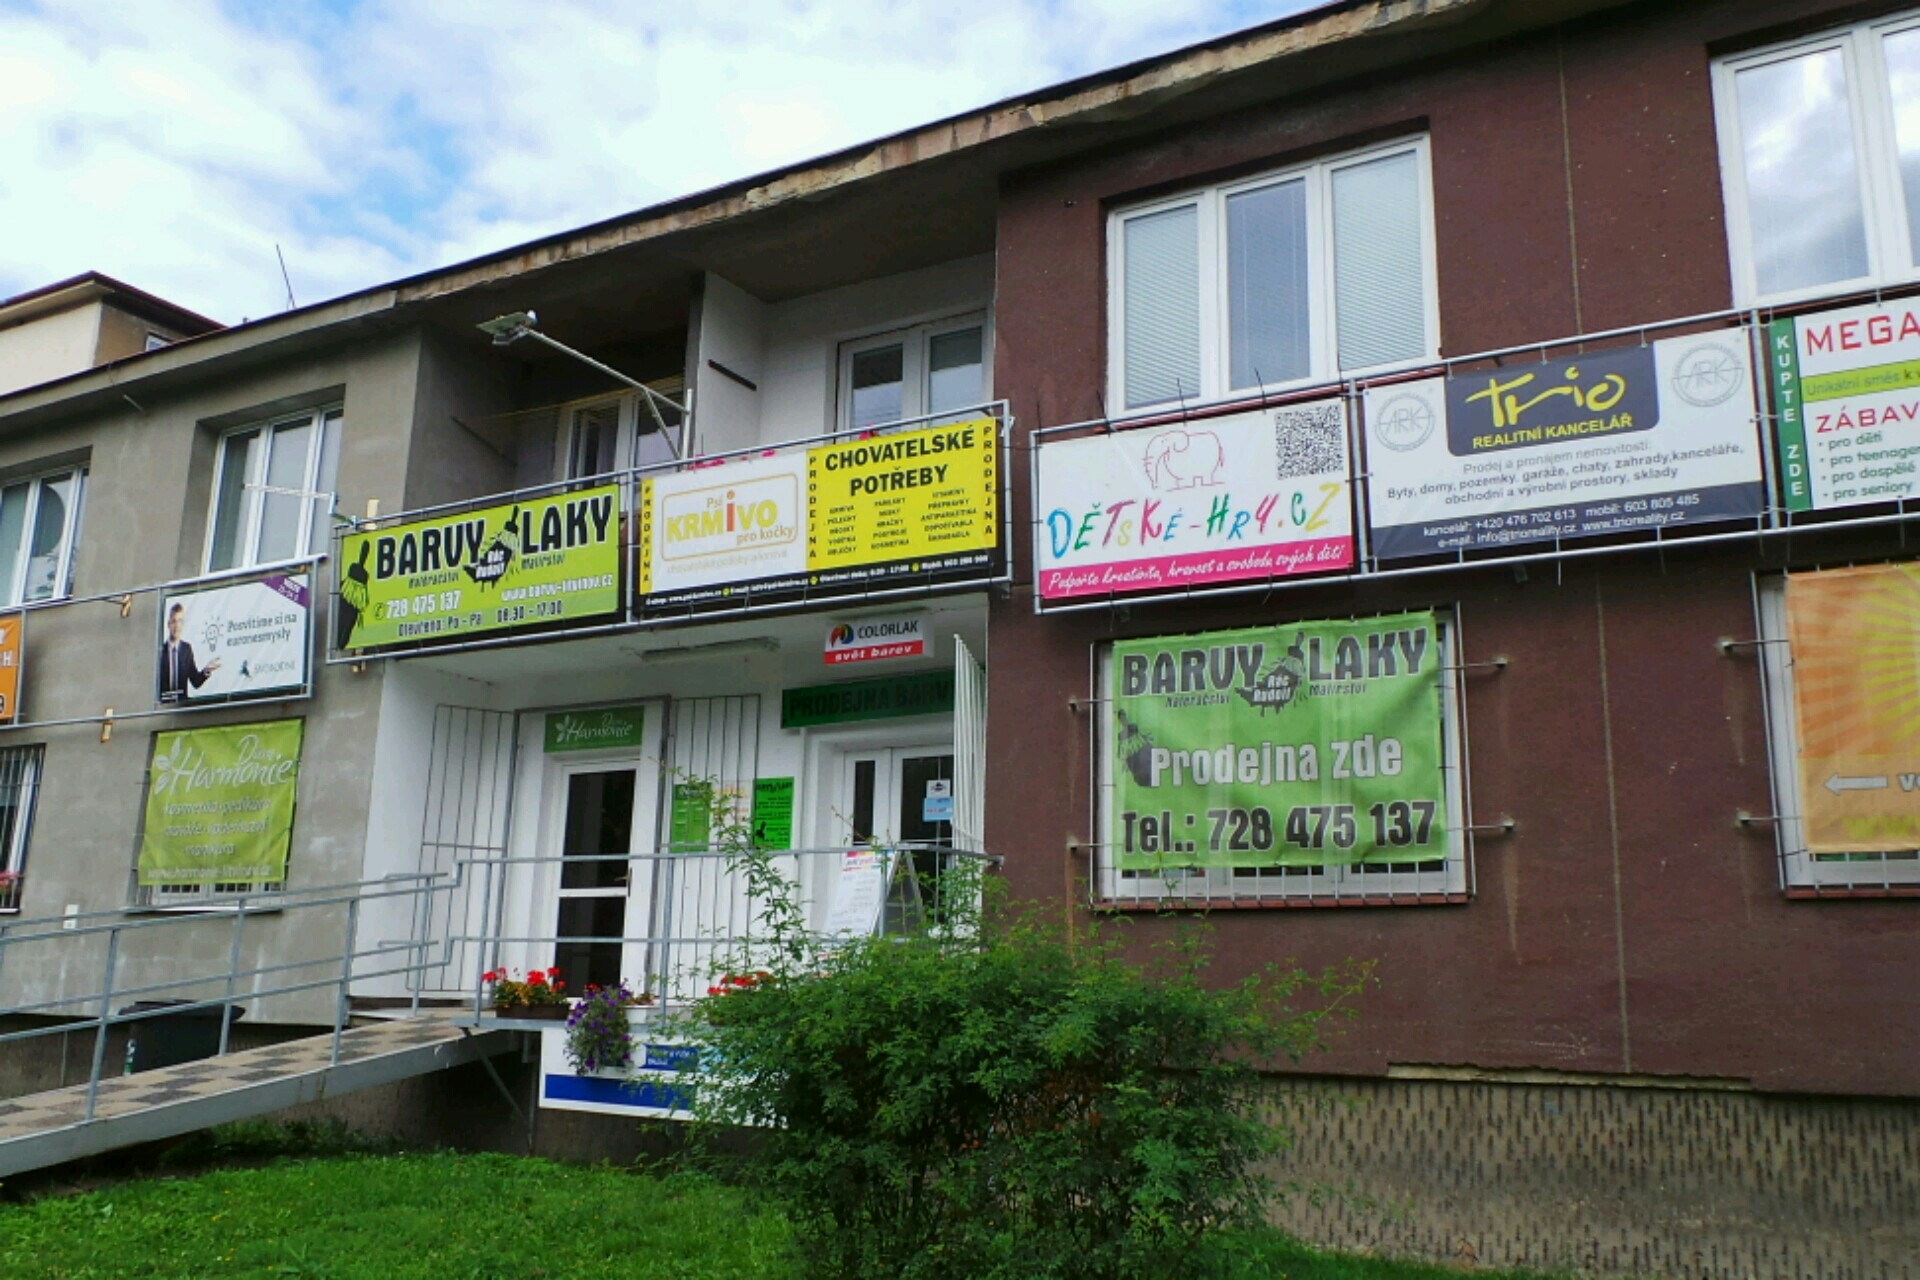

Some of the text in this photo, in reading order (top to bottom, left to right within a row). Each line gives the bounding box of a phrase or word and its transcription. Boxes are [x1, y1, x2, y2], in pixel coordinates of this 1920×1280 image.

[1806, 311, 1920, 356] MEGA
[1777, 336, 1796, 422] KUPTE
[1465, 366, 1626, 428] Trio
[825, 424, 976, 472] CHOVATELSKÉ
[1472, 413, 1632, 449] REALITNÍ KANCELÁŘ
[1828, 430, 1883, 451] pro děti
[1463, 462, 1502, 475] Prodej
[1506, 460, 1514, 469] a
[1516, 451, 1573, 471] pronájem
[1787, 445, 1804, 496] ZDE
[1831, 454, 1854, 468] pro
[1831, 461, 1916, 485] pro dospělé
[850, 463, 949, 497] POTŘEBY
[983, 426, 993, 535] PRODEJNA
[1506, 488, 1515, 497] a
[1633, 466, 1678, 482] sklady
[1833, 481, 1913, 501] pro seniory
[809, 456, 817, 559] PRODEJNA
[1475, 516, 1504, 530] +420
[1530, 512, 1551, 523] 702
[1624, 500, 1648, 513] 603
[375, 495, 614, 581] BARVY LAKY
[643, 486, 651, 582] PRODEJNA
[736, 526, 795, 546] pro kočky
[1167, 559, 1216, 579] hravost
[1275, 547, 1315, 574] svých
[275, 611, 284, 625] si
[284, 612, 297, 624] na
[386, 590, 462, 620] 728 475 137
[858, 619, 919, 640] COLORLAK
[835, 644, 914, 662] svět barev
[1120, 626, 1428, 697] BARVY LAKY
[566, 719, 634, 743] Harmonie
[167, 747, 295, 797] Harmonie
[1150, 733, 1403, 788] Prodejna zde
[1121, 800, 1437, 855] Tel.: 728 475 137
